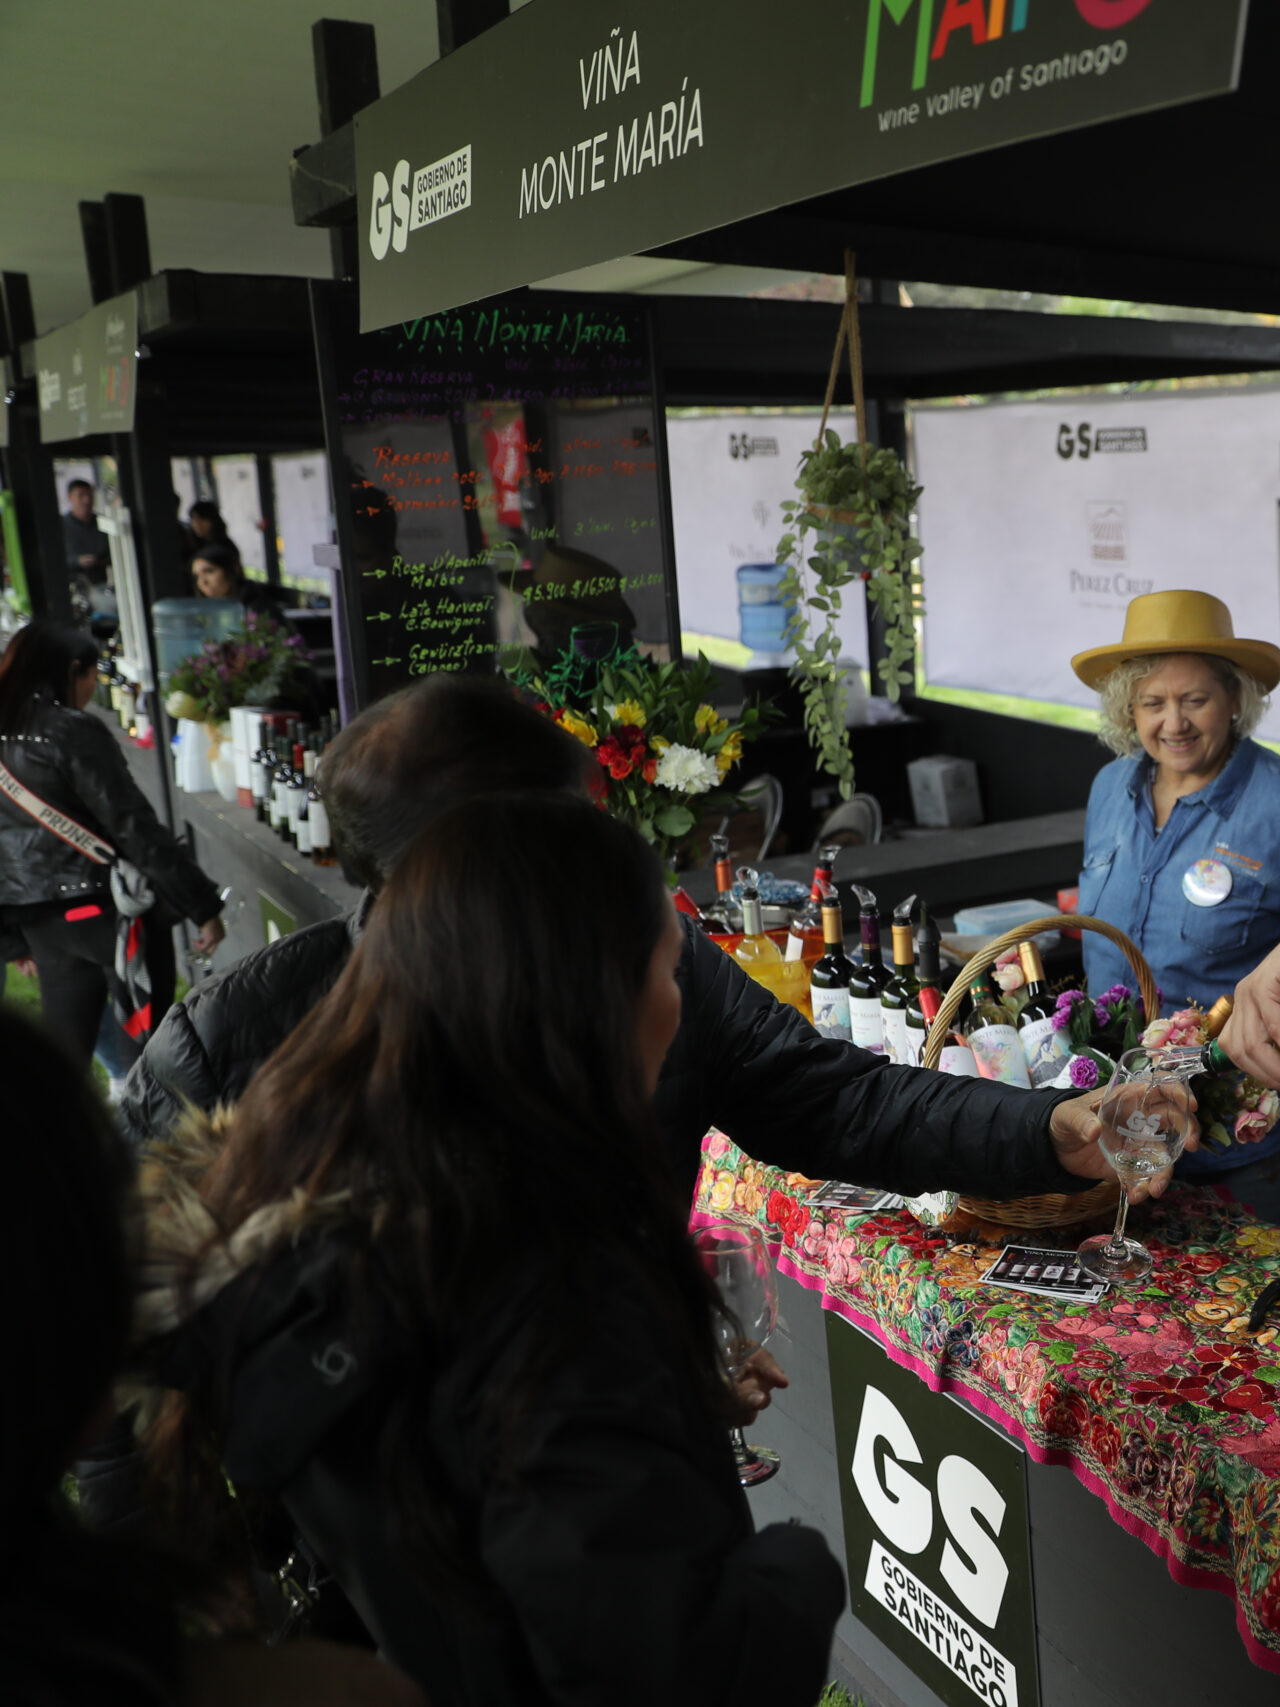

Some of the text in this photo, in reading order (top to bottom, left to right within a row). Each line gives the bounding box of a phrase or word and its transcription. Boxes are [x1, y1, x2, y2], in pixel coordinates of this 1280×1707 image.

[580, 26, 640, 110] VIÑA
[989, 67, 1014, 99] of
[519, 76, 703, 219] MONTE MARÍA
[417, 153, 468, 194] GOBIERNO DE
[369, 159, 410, 260] GS
[418, 180, 468, 223] SANTIAGO
[474, 308, 553, 347] MONTE
[1057, 421, 1092, 460] GS
[39, 807, 96, 850] PRUNE
[1126, 1110, 1162, 1135] GS
[852, 1384, 1010, 1630] GS
[881, 1555, 1006, 1685] GOBIERNO DE
[883, 1581, 1008, 1707] SANTIAGO
